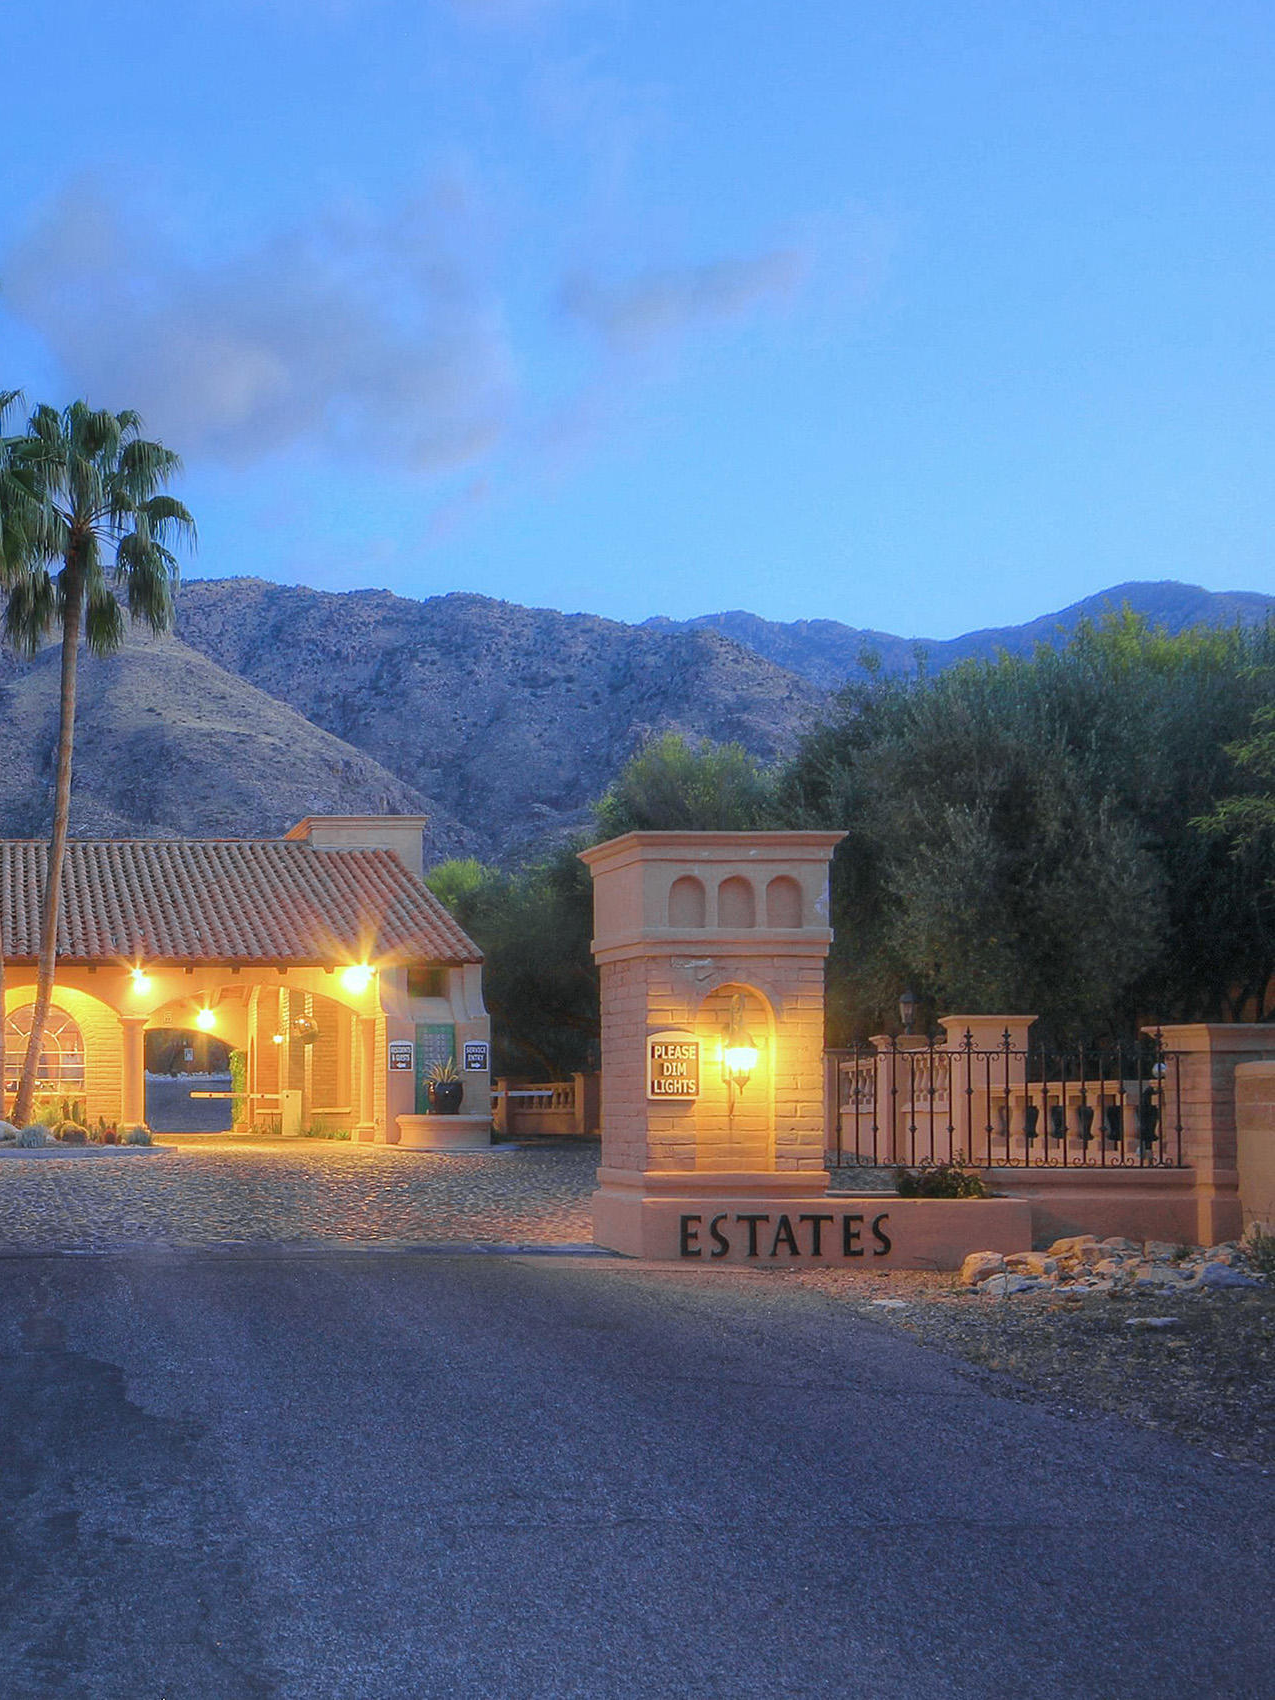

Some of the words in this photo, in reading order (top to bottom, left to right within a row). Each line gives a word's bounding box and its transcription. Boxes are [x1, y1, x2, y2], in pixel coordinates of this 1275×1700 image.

[467, 1053, 484, 1061] ENTRY
[654, 1045, 696, 1059] PLEASE
[663, 1062, 687, 1076] DIM
[654, 1079, 696, 1093] LIGHTS
[679, 1212, 893, 1258] ESTATES
